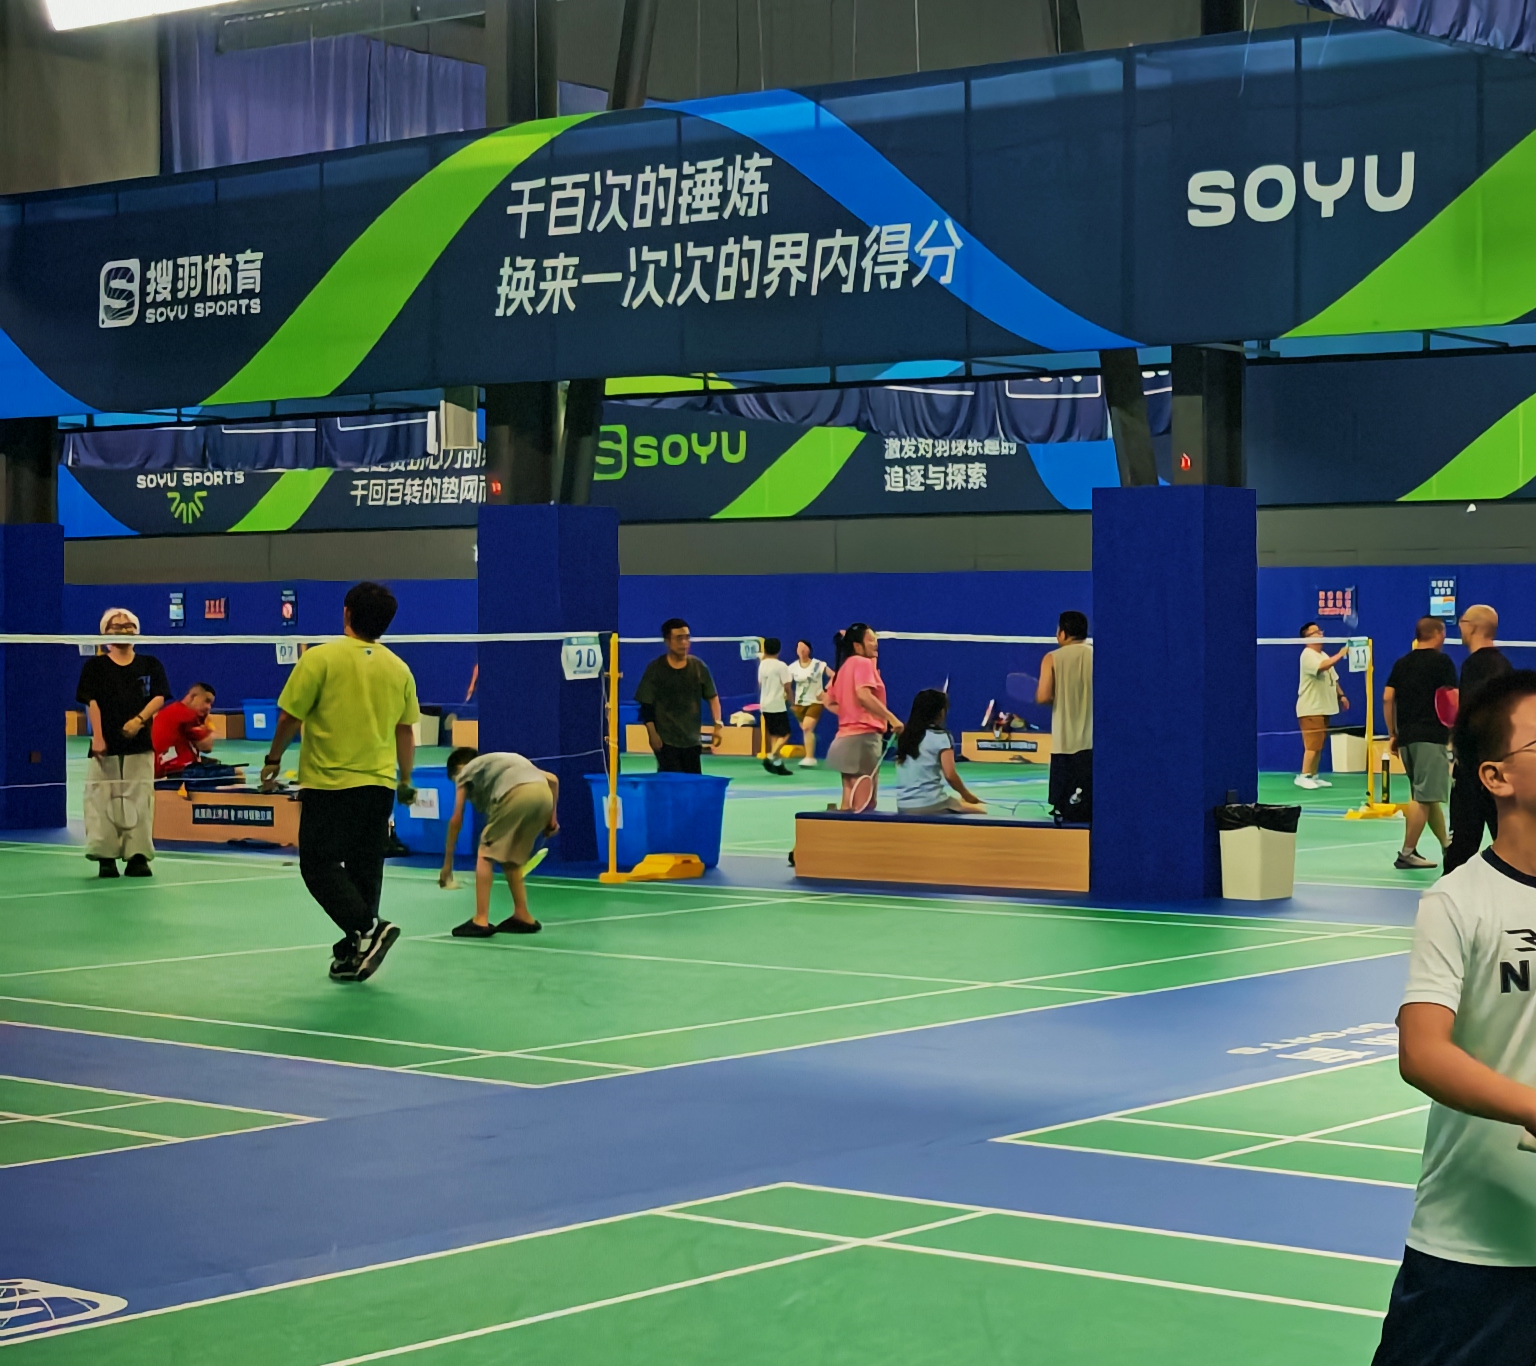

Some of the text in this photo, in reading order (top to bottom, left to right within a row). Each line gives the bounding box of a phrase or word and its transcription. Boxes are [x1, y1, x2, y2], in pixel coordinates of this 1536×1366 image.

[507, 152, 772, 239] 千百次的锤炼
[1188, 152, 1415, 226] SOYU
[146, 248, 263, 303] 搜羽体育
[495, 219, 963, 316] 换来一次次的界内得分
[146, 298, 260, 323] SOYU SPORTS
[634, 431, 746, 467] SOYU
[137, 470, 245, 489] SOYU SPORTS
[884, 462, 988, 492] 追逐与探索
[1355, 649, 1367, 664] 11
